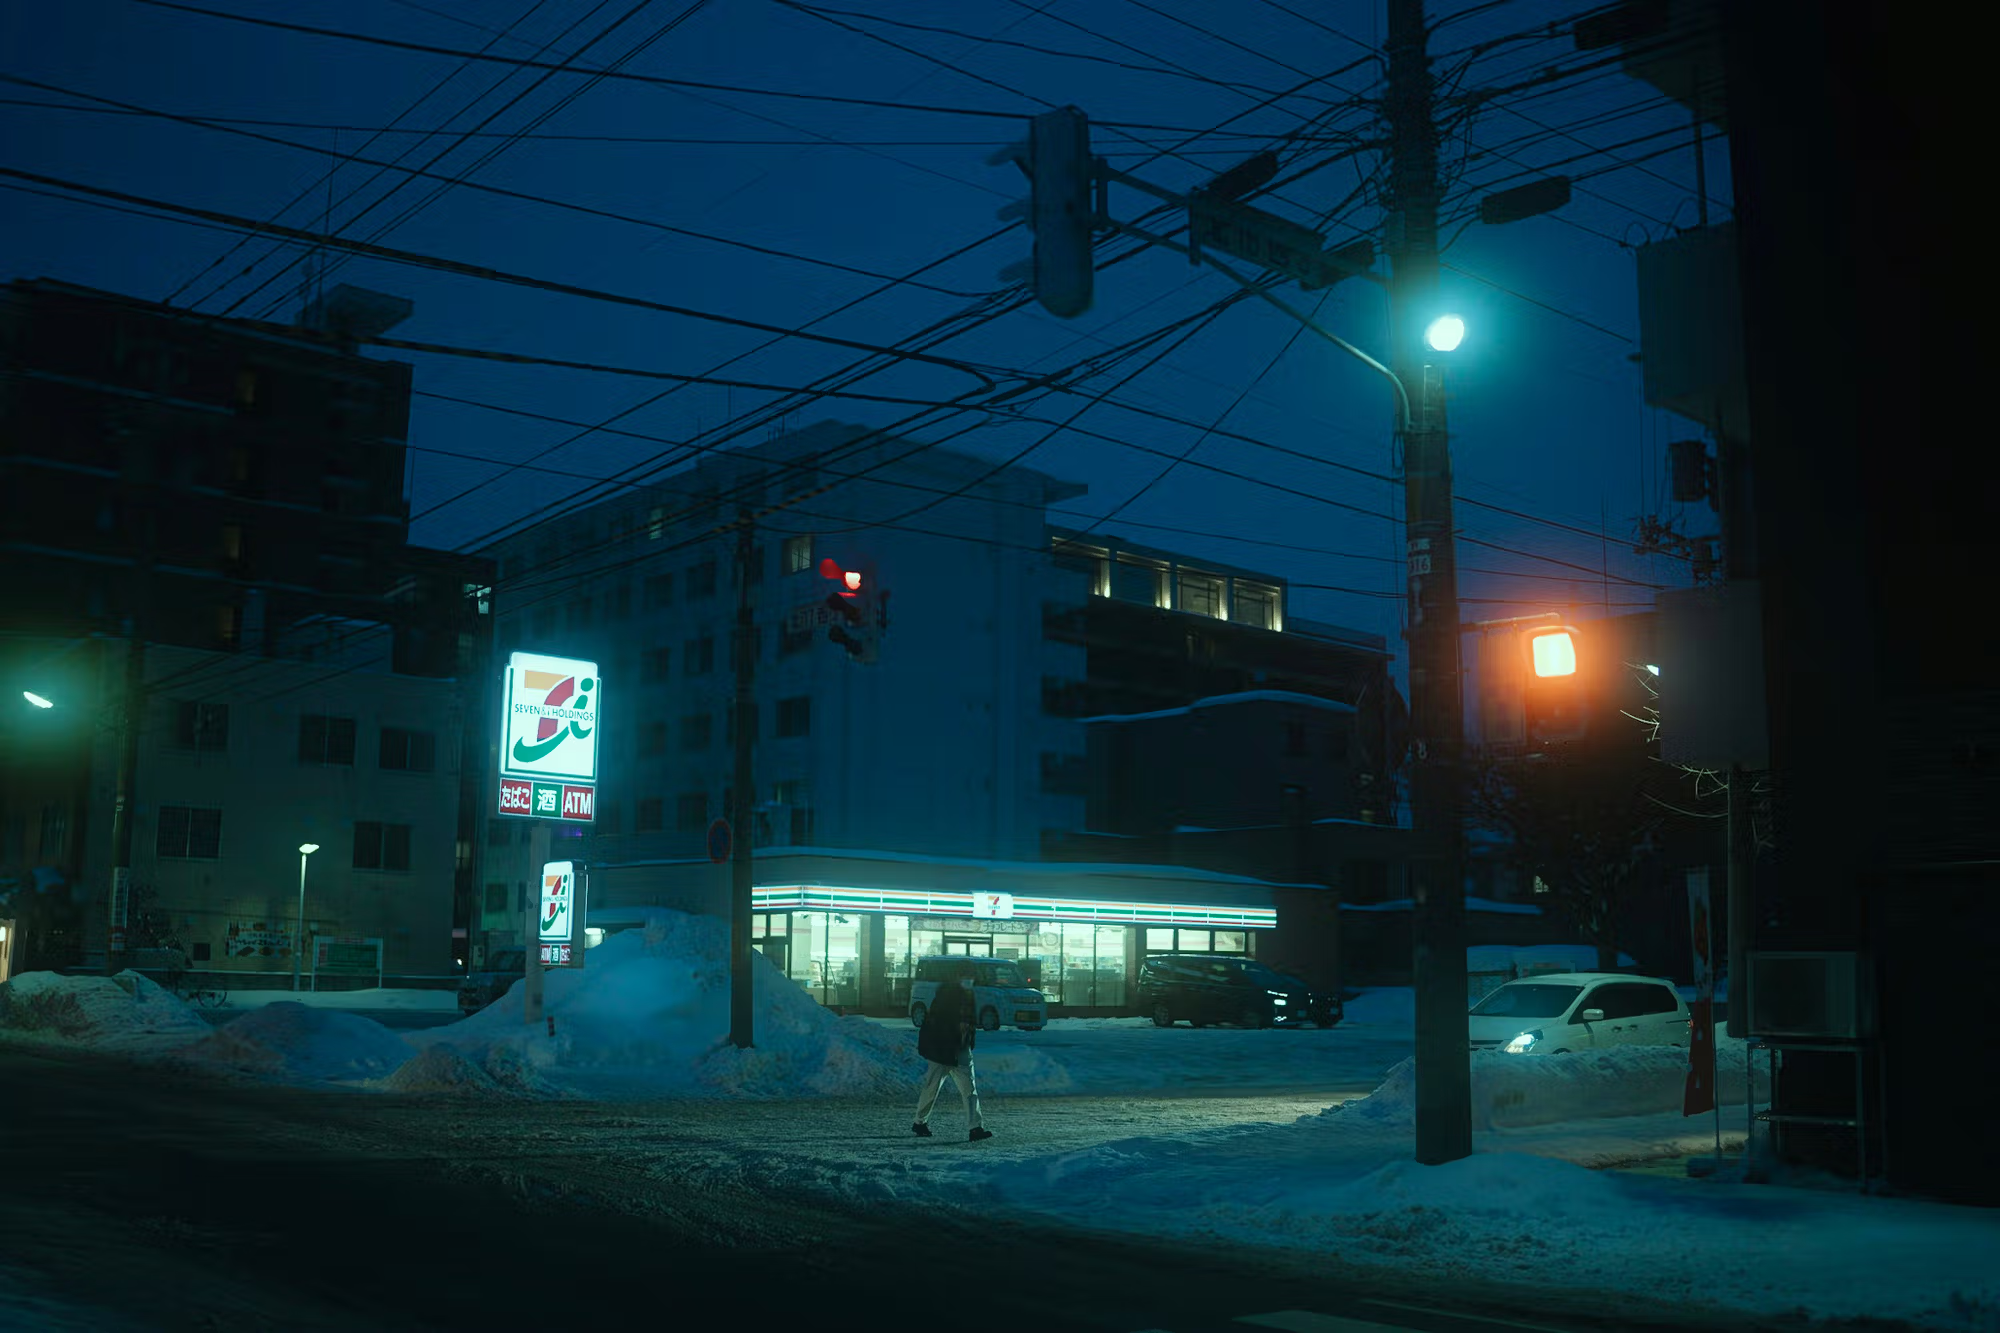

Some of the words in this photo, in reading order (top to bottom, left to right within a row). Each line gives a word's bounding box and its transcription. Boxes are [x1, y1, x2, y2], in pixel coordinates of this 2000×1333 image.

[552, 708, 594, 721] HOLDINGS
[501, 785, 530, 809] たばこ
[537, 788, 557, 811] 酒
[564, 791, 592, 815] ATM
